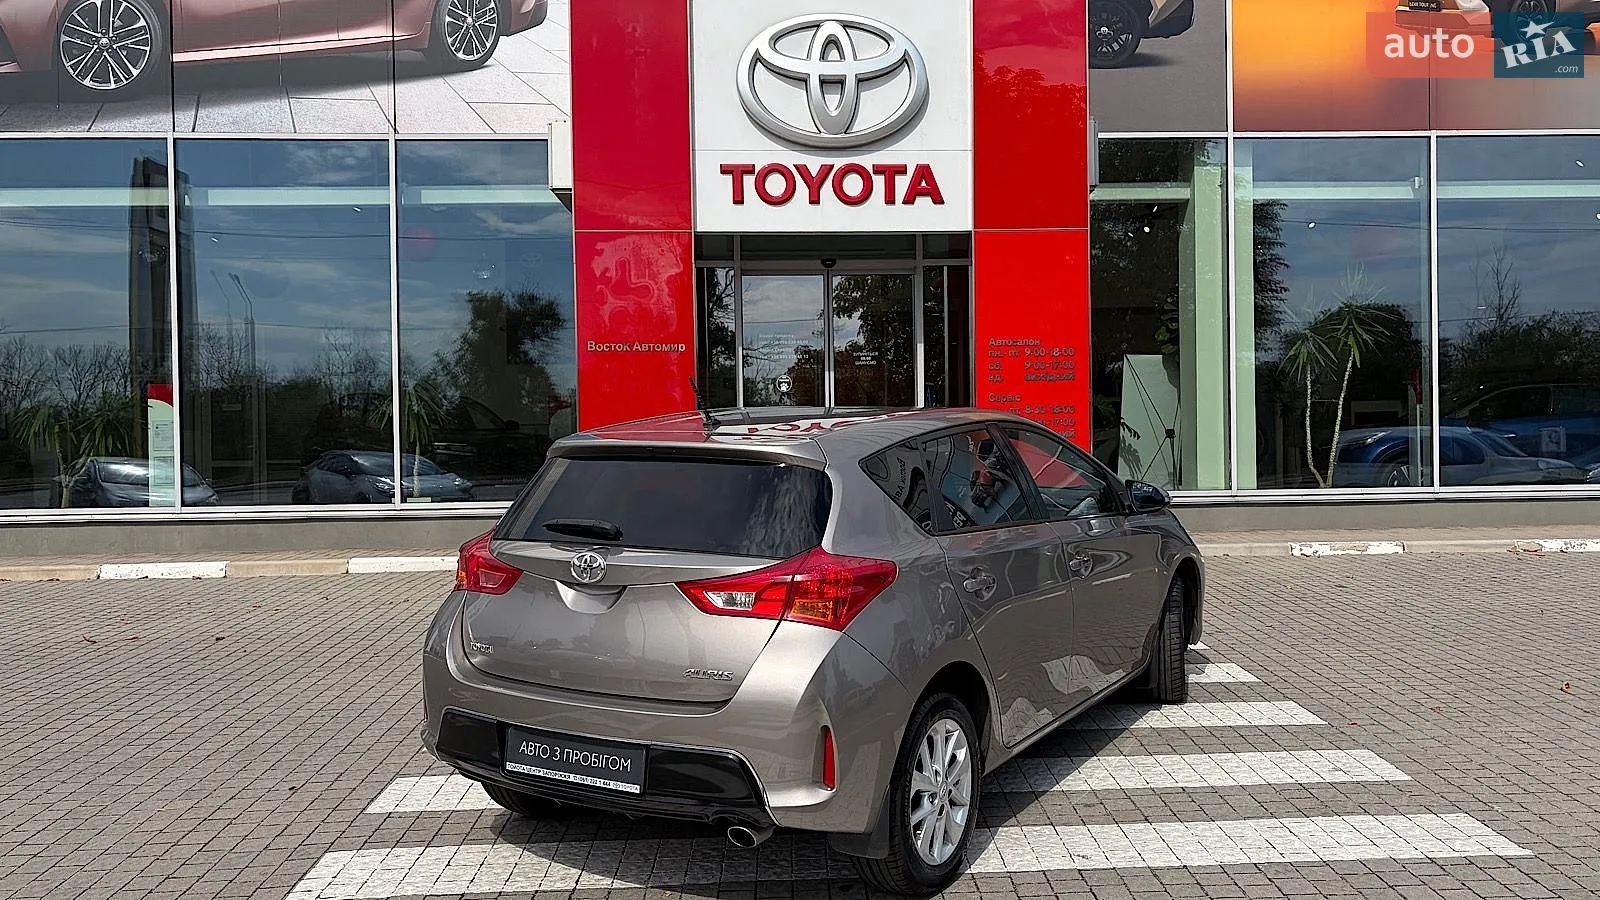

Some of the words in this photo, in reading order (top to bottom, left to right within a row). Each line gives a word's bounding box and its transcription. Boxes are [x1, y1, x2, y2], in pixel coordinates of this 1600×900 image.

[719, 162, 945, 206] TOYOTA
[587, 340, 630, 351] Восток
[632, 340, 686, 353] Автомир
[988, 338, 1041, 346] Автосалон
[682, 668, 734, 681] AURIS
[518, 740, 550, 759] АВТО
[563, 749, 632, 773] ПРОБІГОМ
